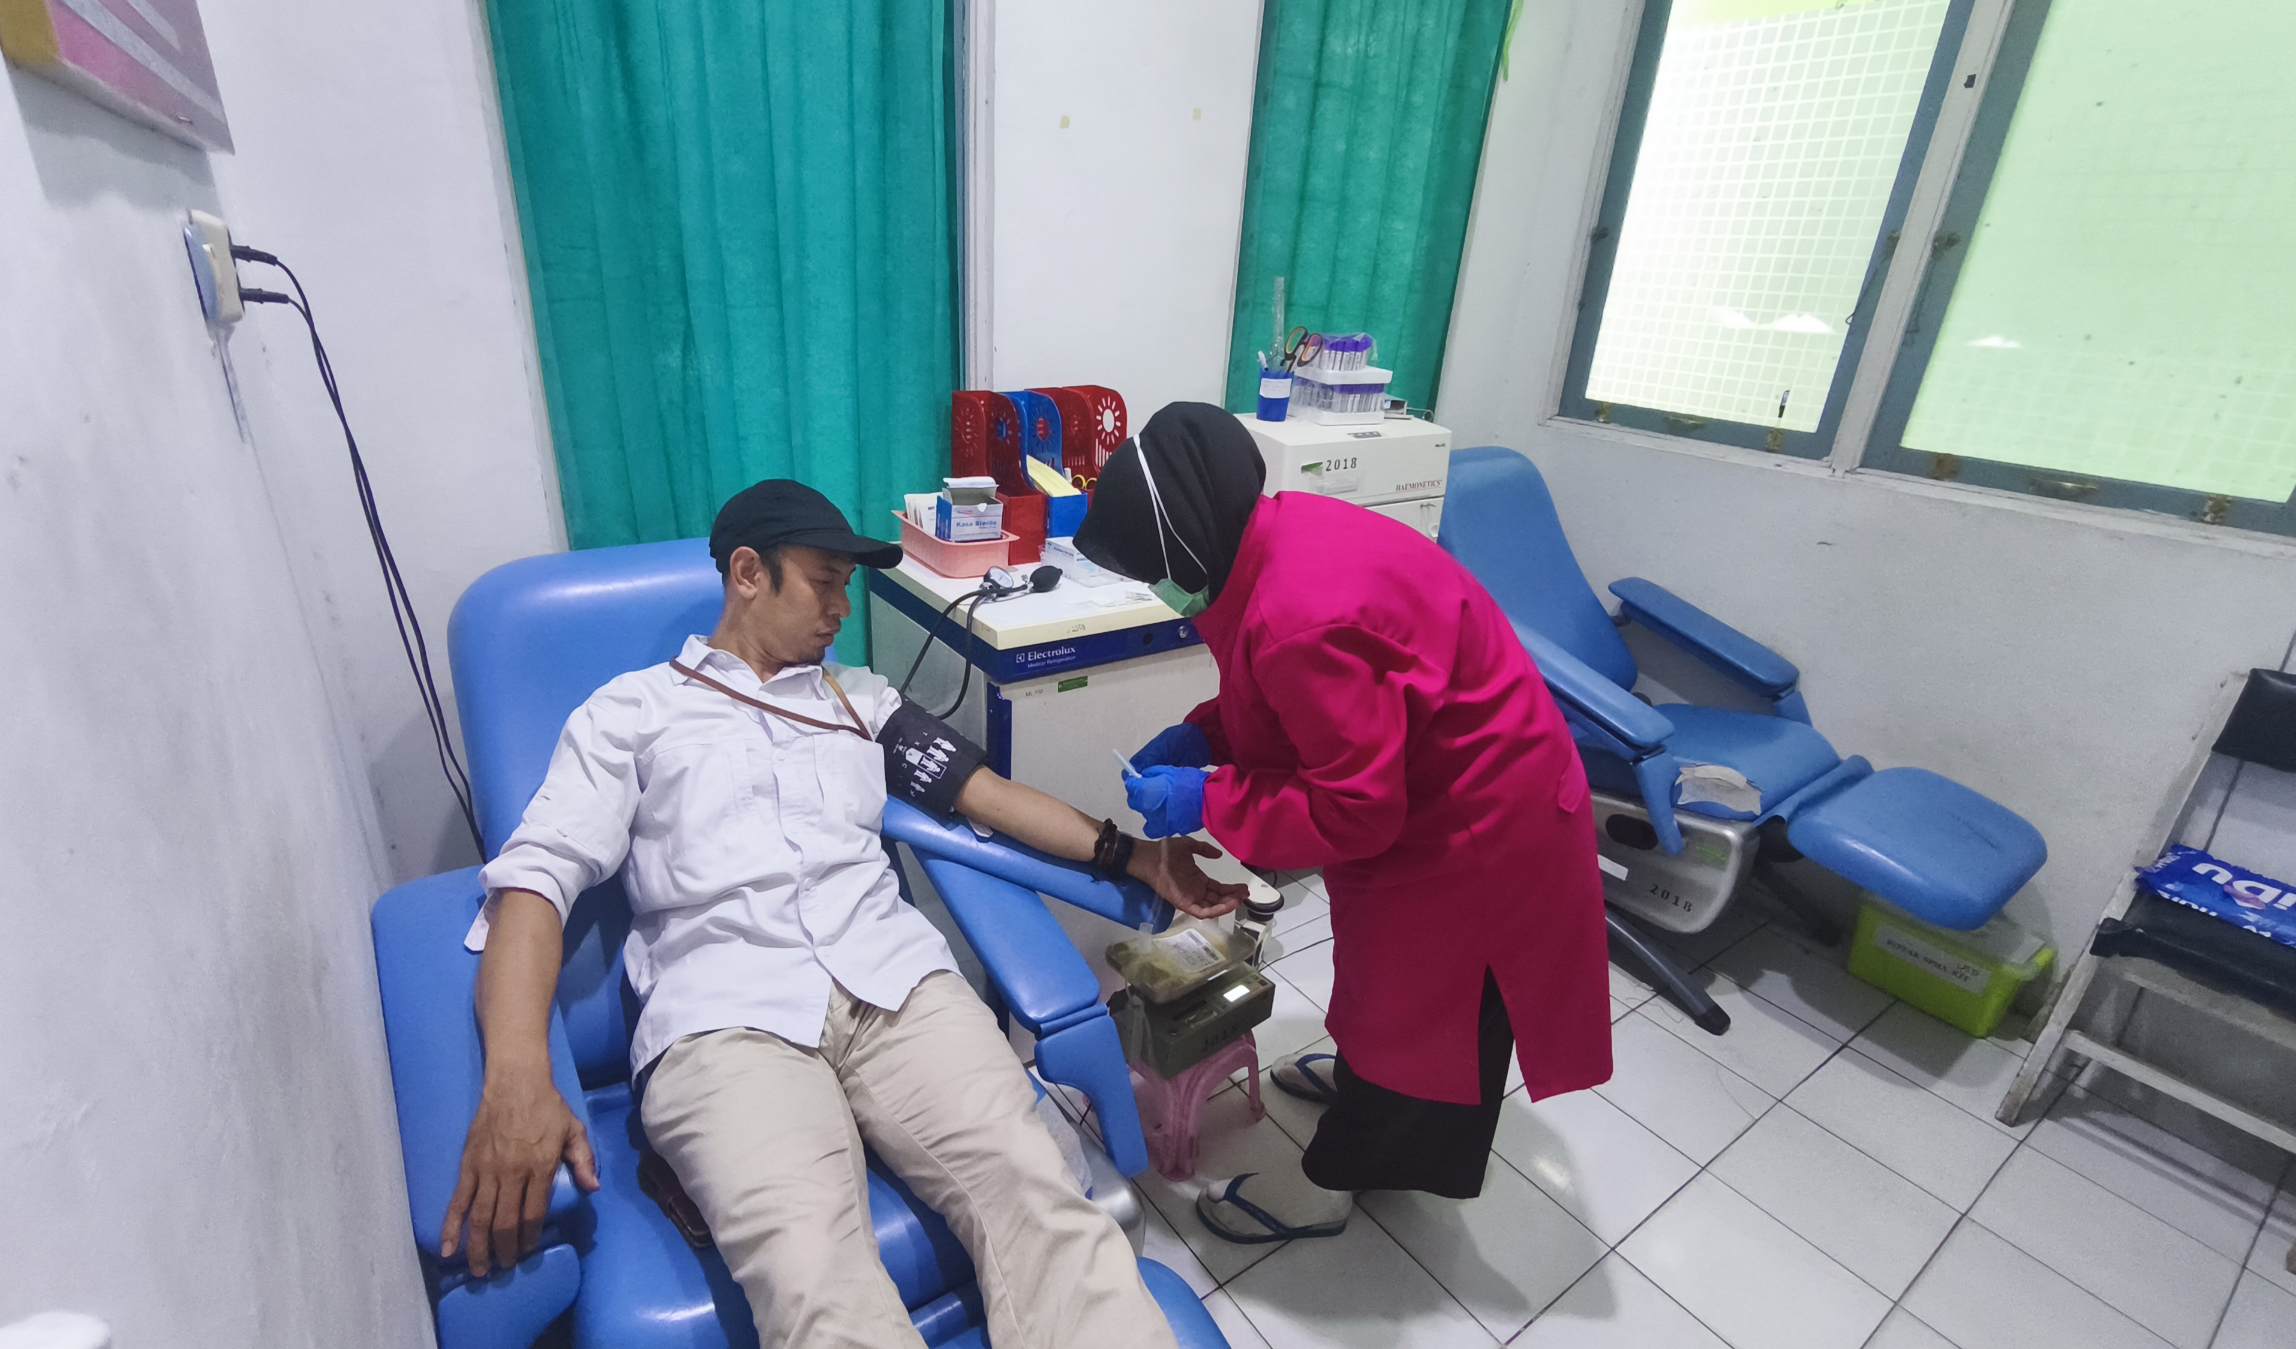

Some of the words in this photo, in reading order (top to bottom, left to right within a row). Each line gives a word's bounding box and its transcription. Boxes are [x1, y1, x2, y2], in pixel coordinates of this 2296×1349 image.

[1326, 457, 1357, 472] 2018
[1395, 480, 1442, 491] HAEMONETICS
[1028, 646, 1076, 661] Electrolux
[1649, 883, 1693, 912] 2018
